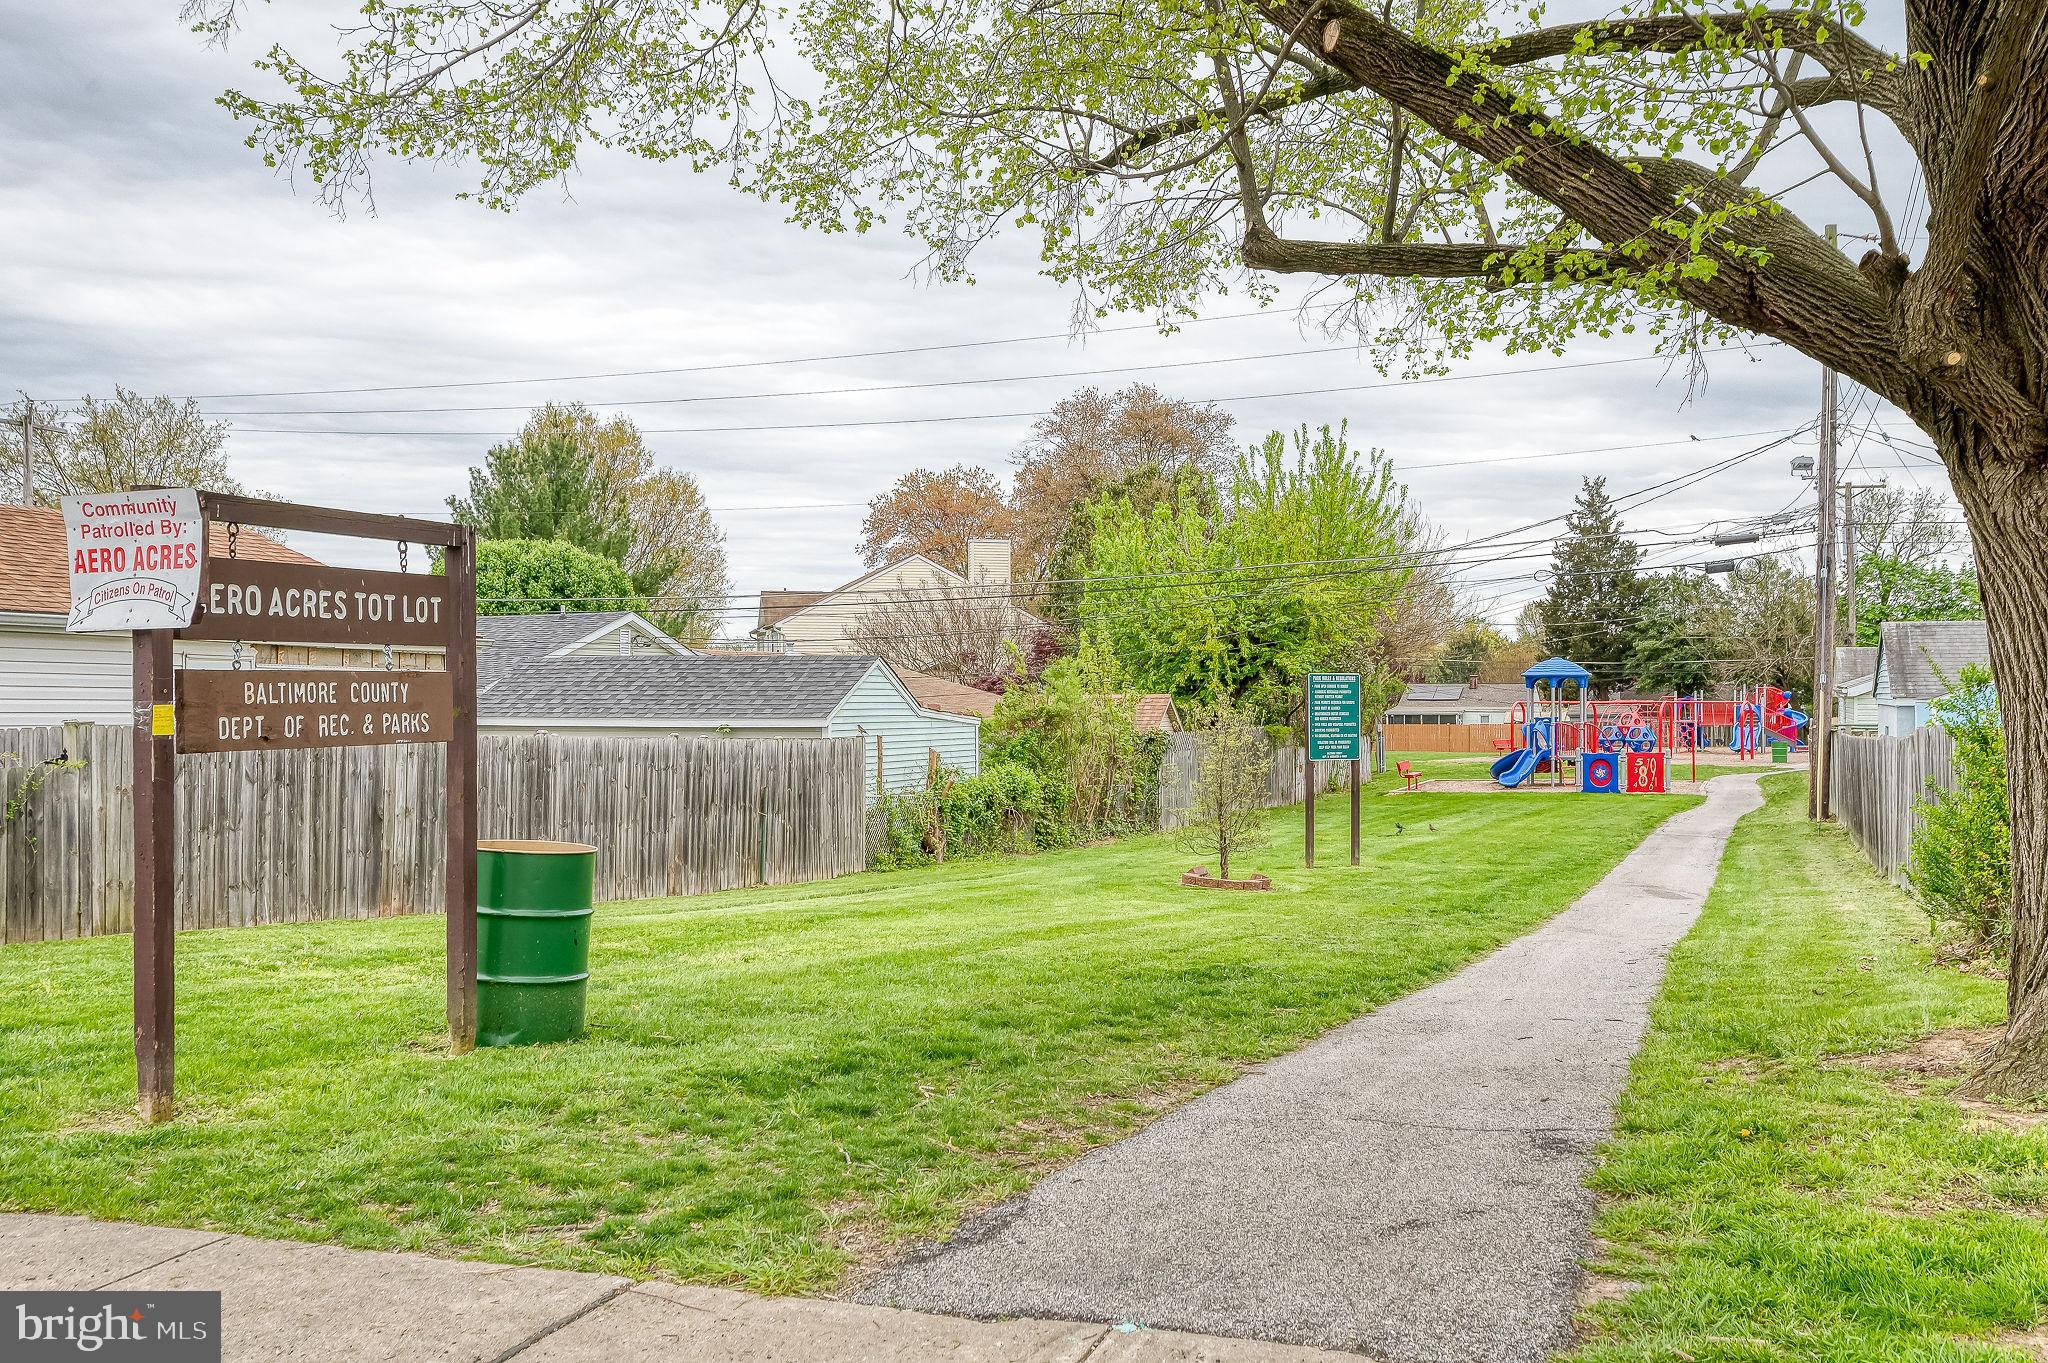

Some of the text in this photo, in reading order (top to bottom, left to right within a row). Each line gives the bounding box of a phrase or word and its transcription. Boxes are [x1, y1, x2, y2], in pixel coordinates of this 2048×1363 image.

[82, 498, 177, 518] Community
[81, 519, 187, 539] Patrolled By:
[75, 542, 197, 574] AERO ACRES
[94, 581, 175, 605] Citizens On Patrol
[201, 582, 441, 624] ERO ACRES TOT LOT
[244, 681, 409, 705] BALTIMORE COUNTY
[284, 715, 305, 738] OF
[319, 714, 354, 737] REC.
[362, 714, 374, 735] &
[382, 712, 430, 736] PARKS
